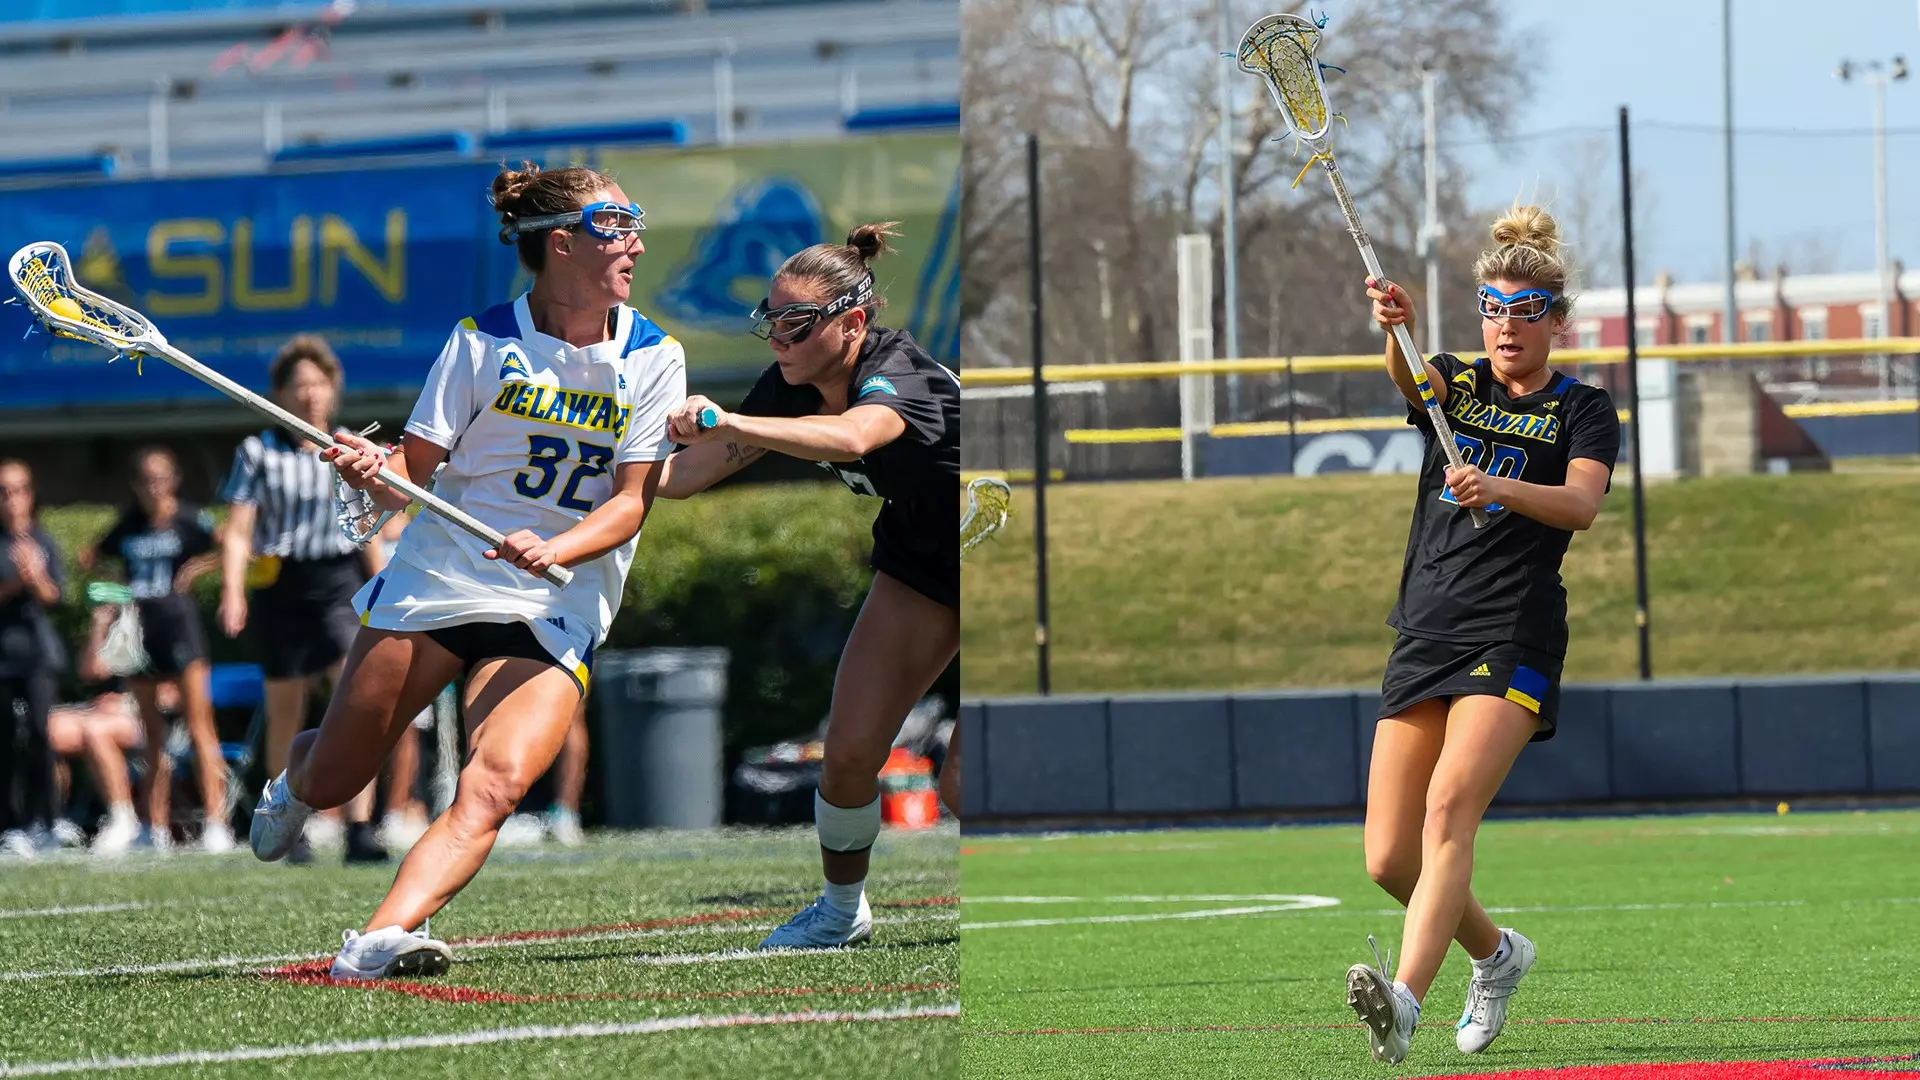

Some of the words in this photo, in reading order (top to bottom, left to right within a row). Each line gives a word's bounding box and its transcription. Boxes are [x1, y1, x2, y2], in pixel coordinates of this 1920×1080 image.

[147, 209, 407, 316] SUN
[827, 291, 853, 315] STX
[1447, 386, 1561, 444] DELAWARE
[513, 434, 615, 512] 32
